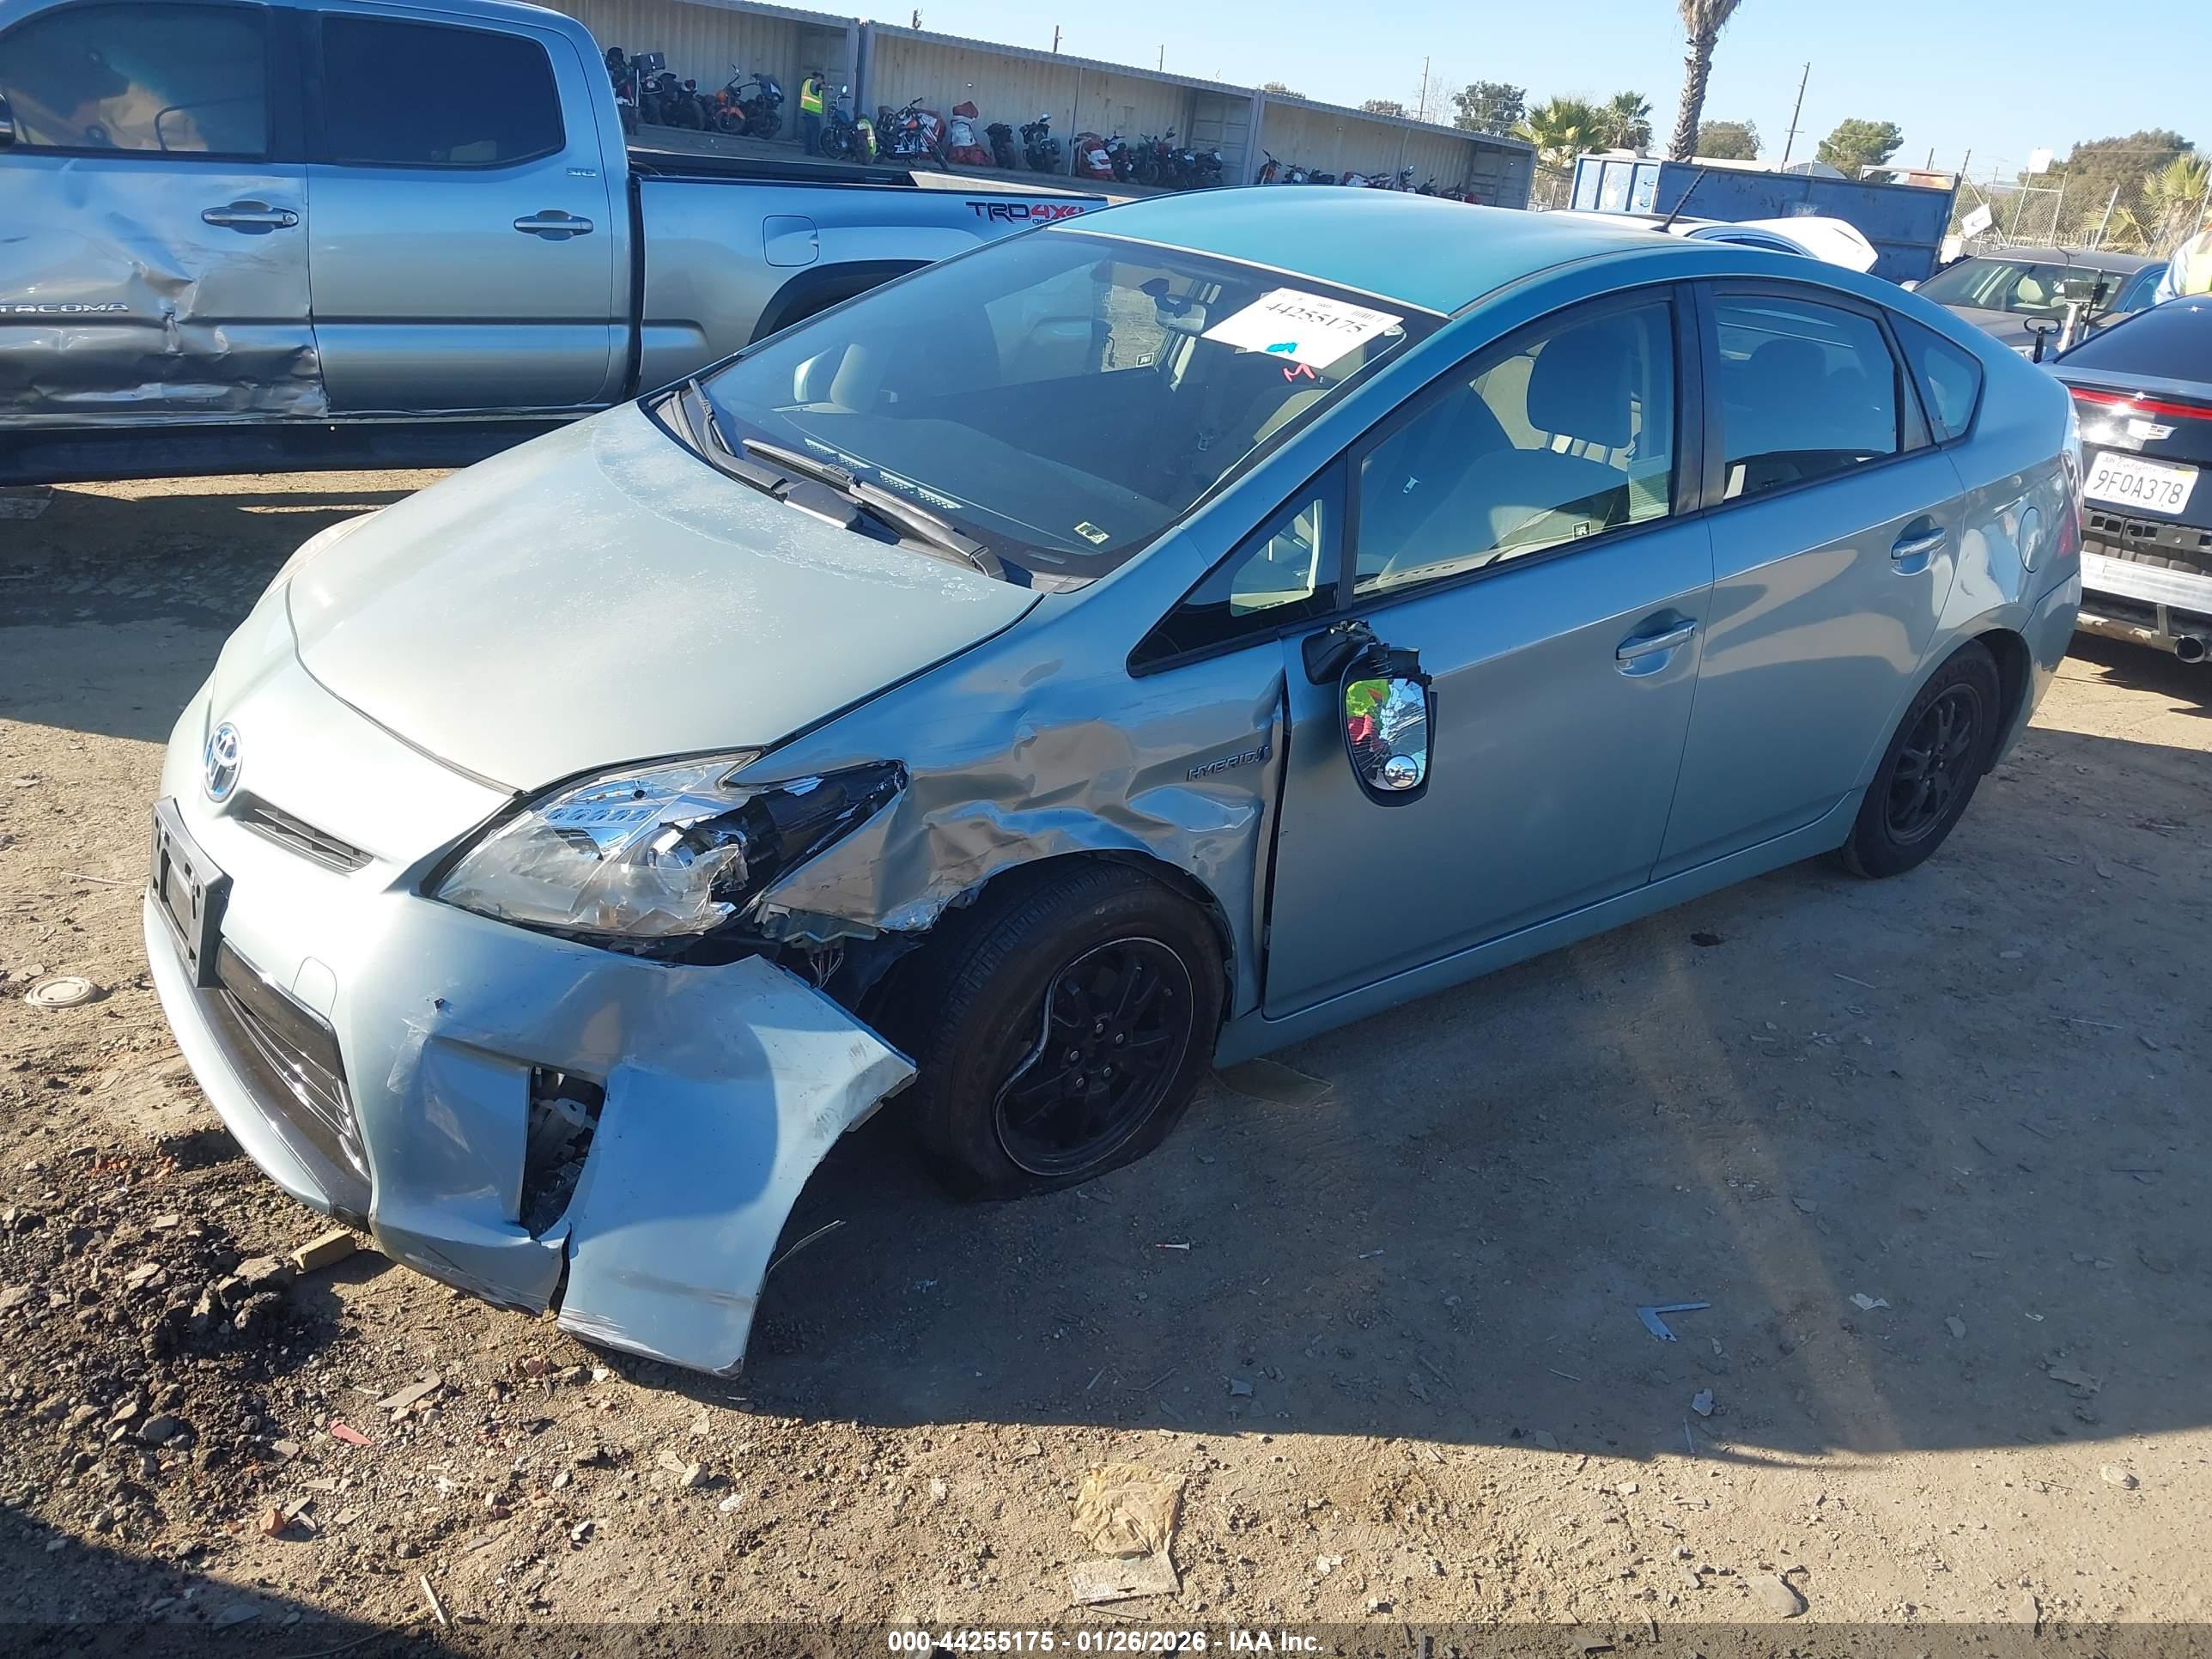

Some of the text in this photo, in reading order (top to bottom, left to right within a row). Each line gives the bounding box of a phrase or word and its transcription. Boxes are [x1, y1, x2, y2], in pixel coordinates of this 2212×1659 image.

[0, 302, 129, 313] TACOMA
[1265, 302, 1370, 334] 44255175
[2093, 470, 2185, 505] 9FQA378
[1187, 751, 1257, 782] HYBRID
